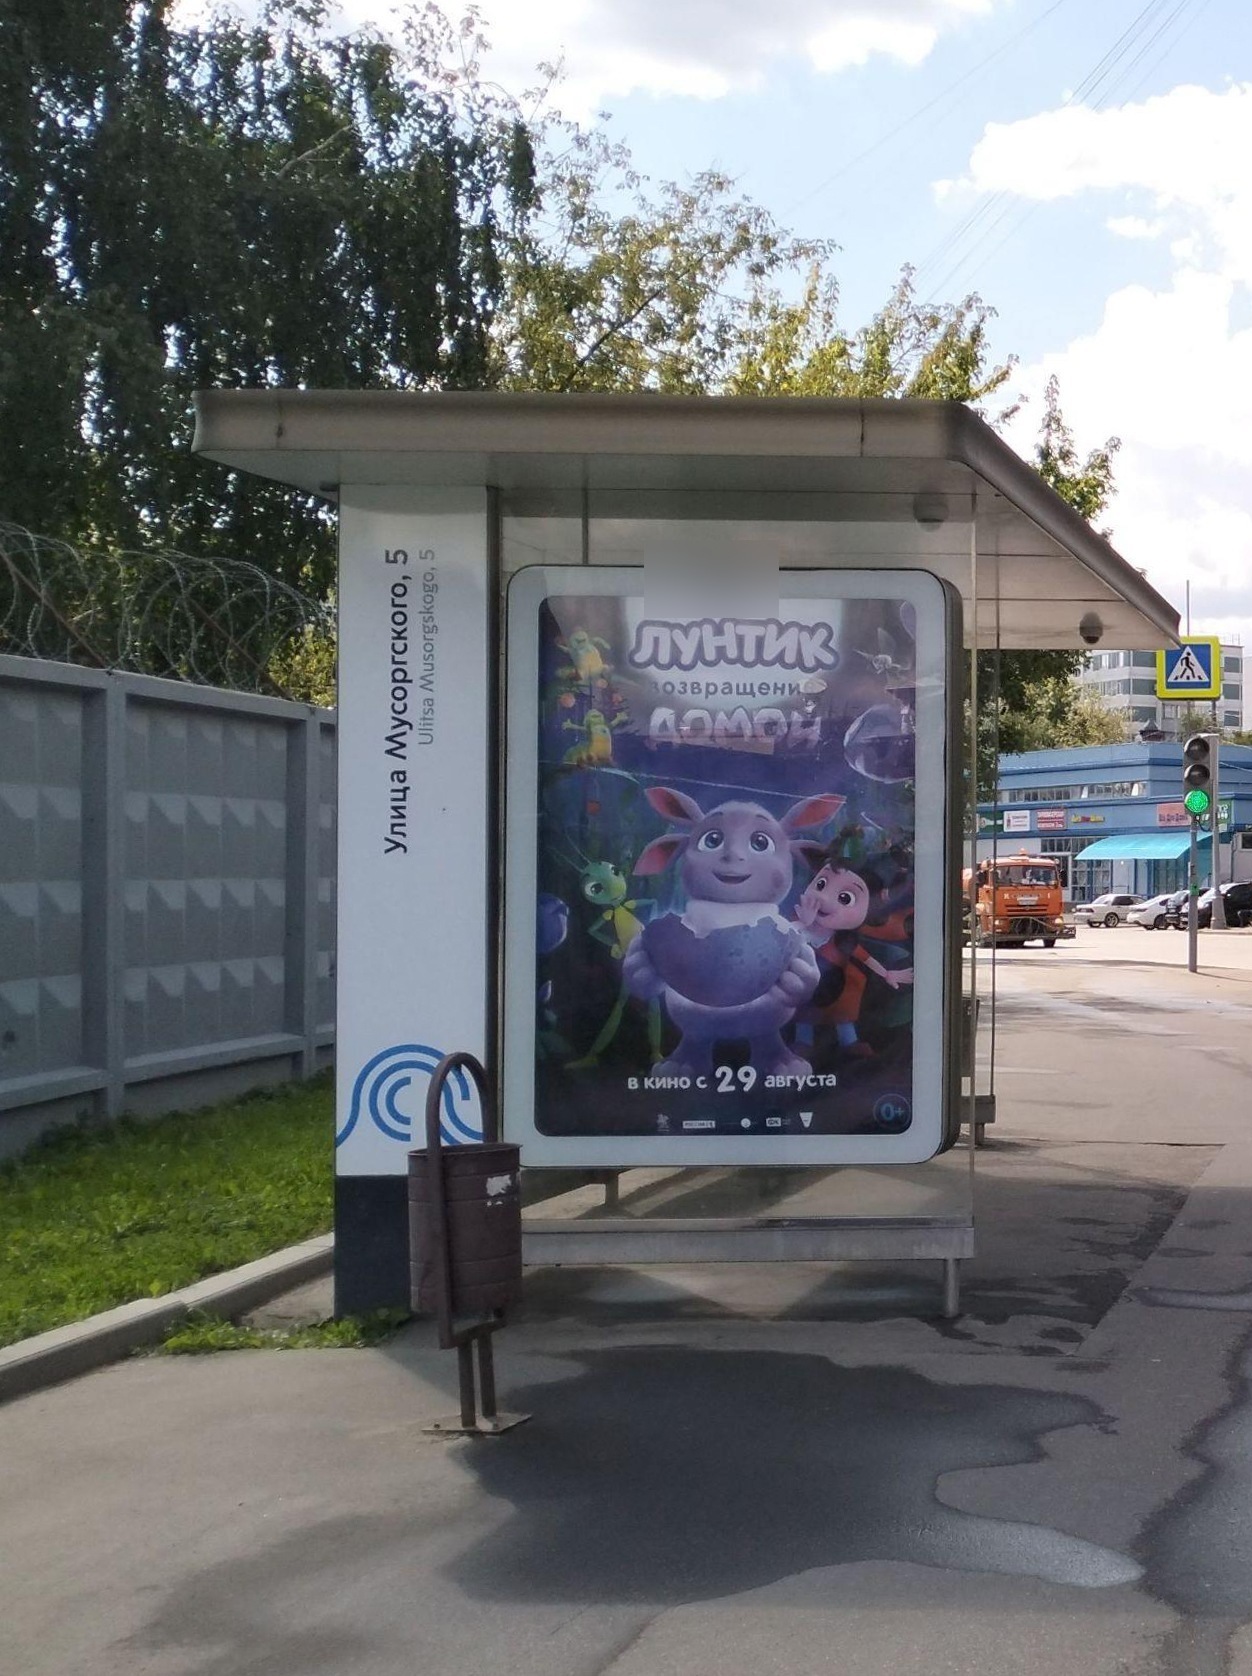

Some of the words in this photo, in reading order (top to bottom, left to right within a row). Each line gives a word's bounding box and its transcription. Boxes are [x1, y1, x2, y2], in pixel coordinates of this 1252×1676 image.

[385, 549, 408, 565] 5
[419, 549, 435, 560] 5
[417, 567, 439, 692] Musorgskogo,
[631, 620, 837, 670] ЛУНТИК
[384, 575, 413, 760] Мусоргского,
[650, 681, 802, 698] возвращени
[417, 698, 434, 744] Ulitsa
[384, 769, 411, 854] Улица
[627, 1077, 639, 1089] в
[643, 1076, 691, 1089] кино
[695, 1076, 708, 1088] с
[714, 1065, 757, 1093] 29
[764, 1074, 837, 1091] августа
[881, 1103, 905, 1120] 0+
